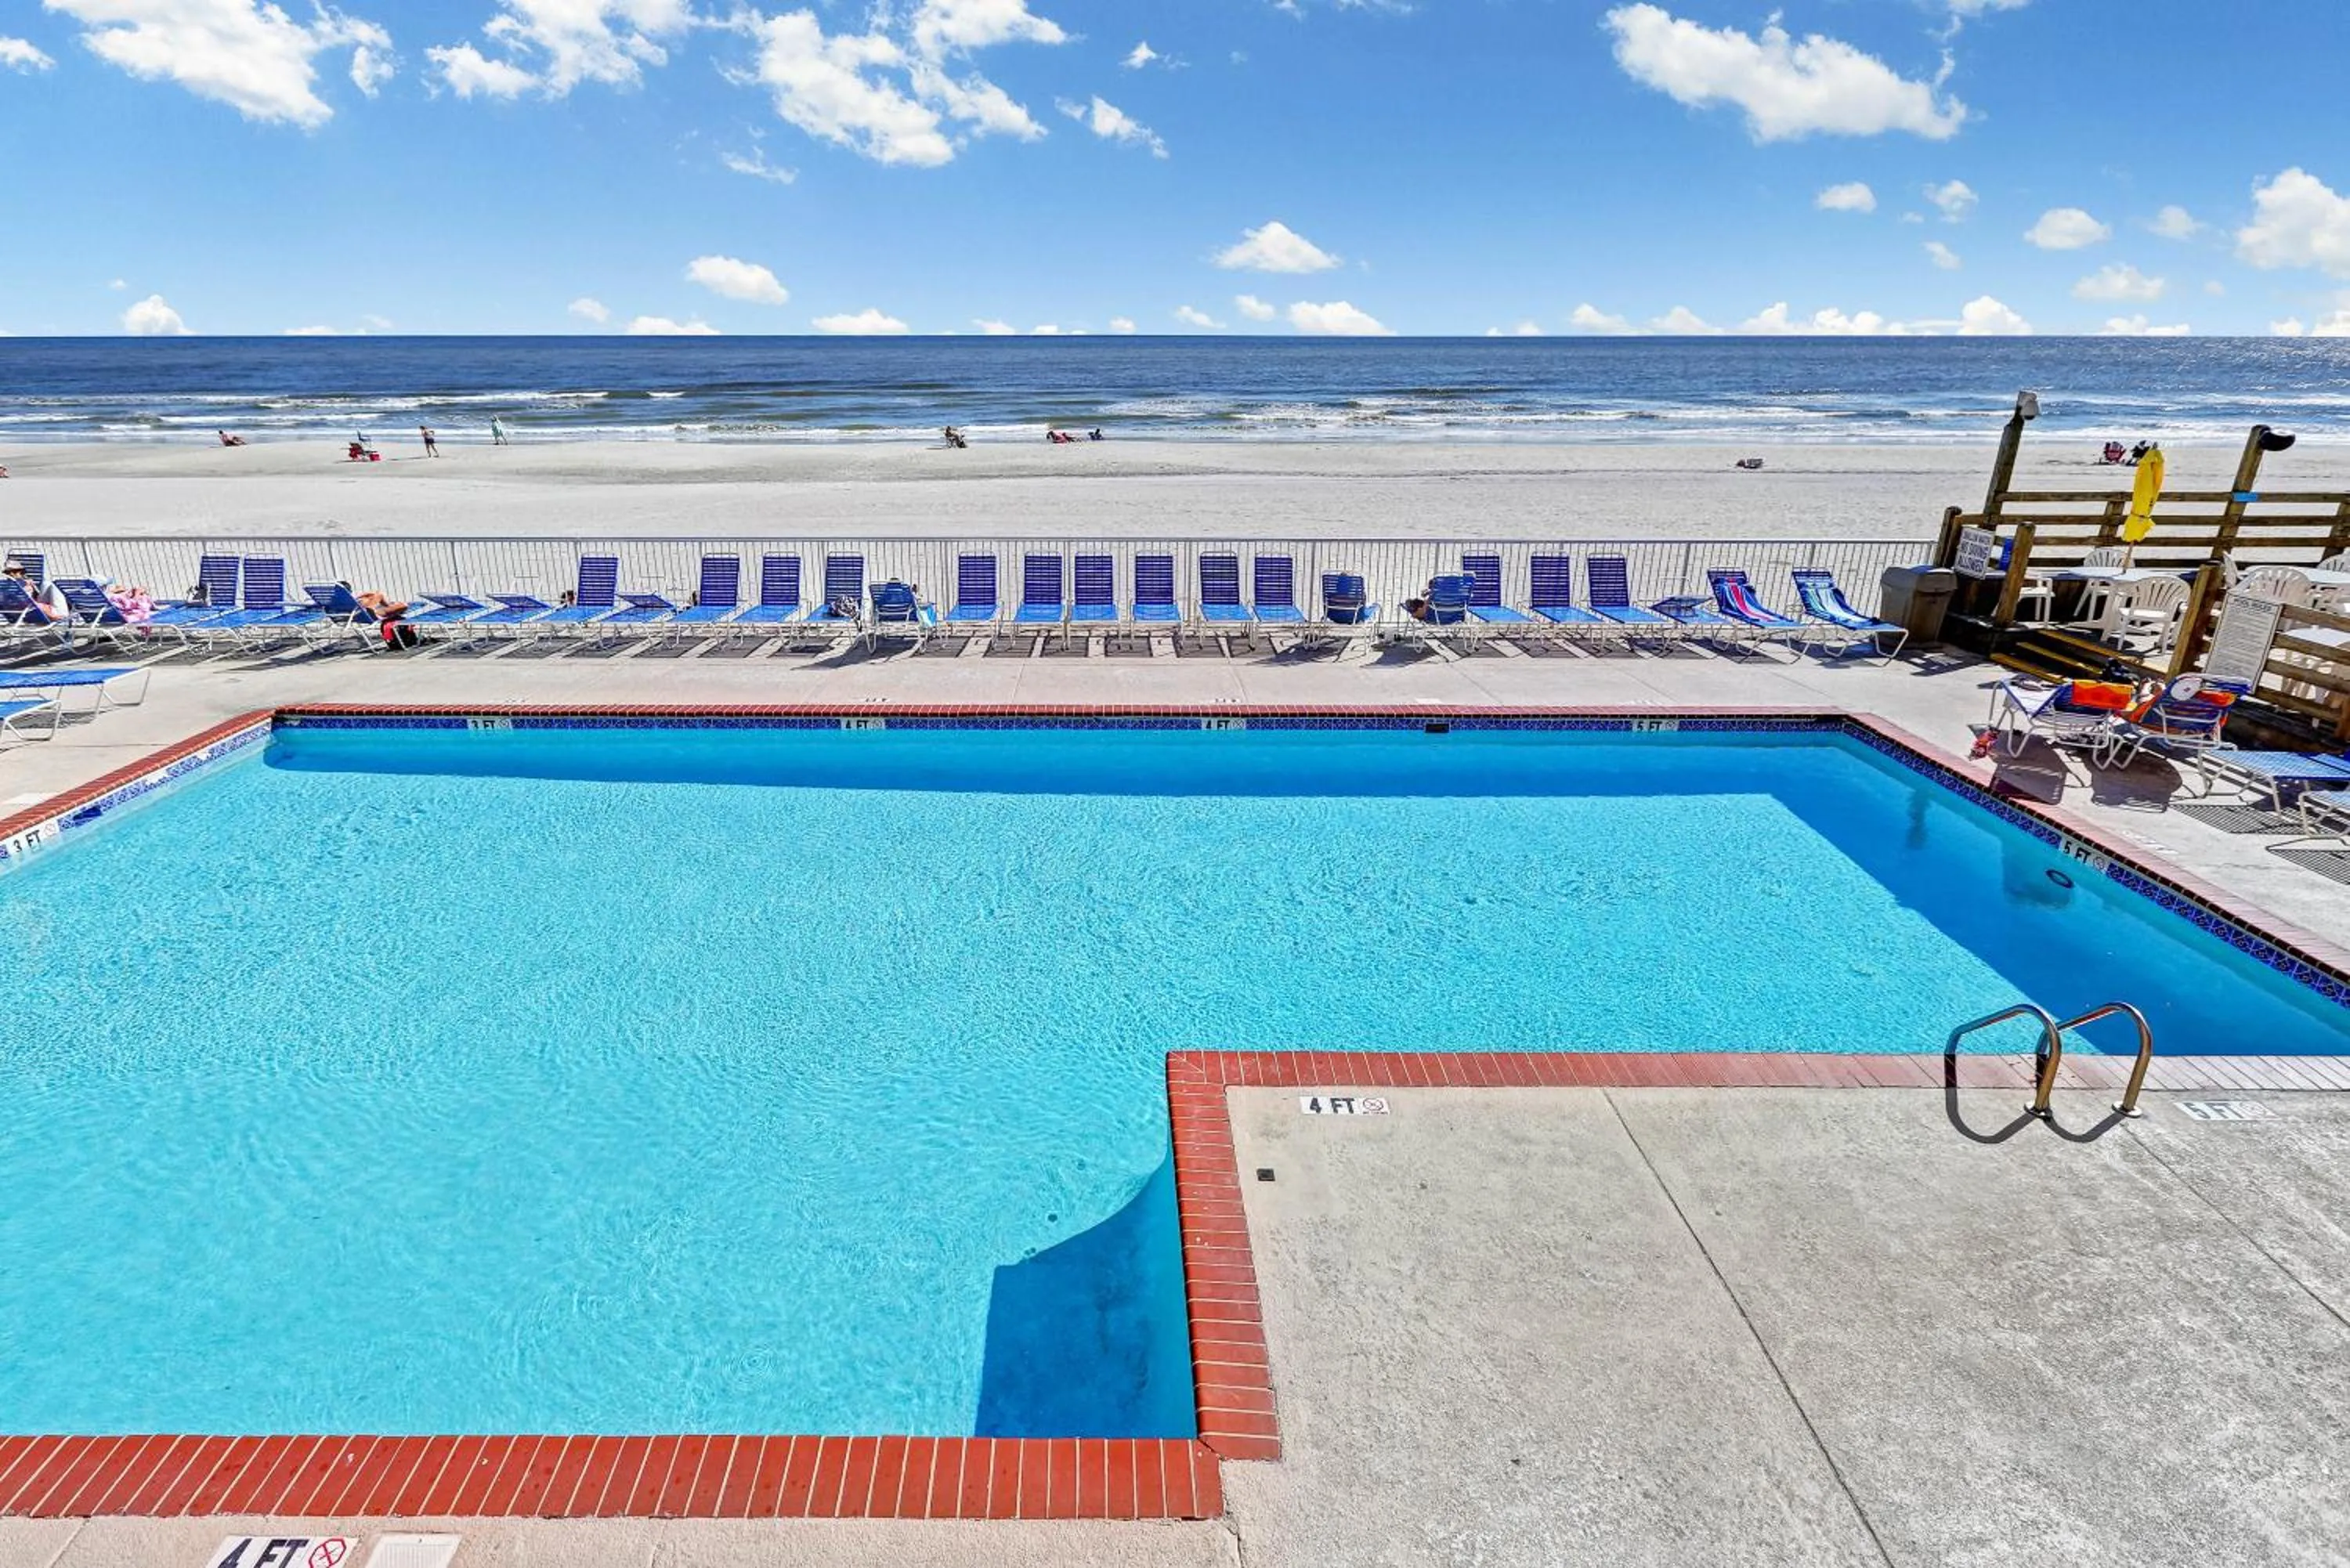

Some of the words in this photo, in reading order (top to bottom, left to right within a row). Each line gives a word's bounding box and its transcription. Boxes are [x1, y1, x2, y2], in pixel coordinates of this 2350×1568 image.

[856, 720, 869, 730] FT
[1206, 720, 1212, 729] 4
[1217, 720, 1230, 730] FT
[1637, 721, 1644, 732] 5
[1648, 721, 1662, 732] FT
[13, 839, 23, 853] 3
[25, 829, 41, 848] FT
[2063, 840, 2072, 854] 5
[2074, 847, 2091, 864] FT
[1309, 1097, 1322, 1113] 4
[1329, 1097, 1355, 1114] FT
[2183, 1102, 2211, 1119] 5
[2204, 1102, 2245, 1119] FT
[217, 1538, 253, 1568] 4
[253, 1539, 309, 1568] FT
